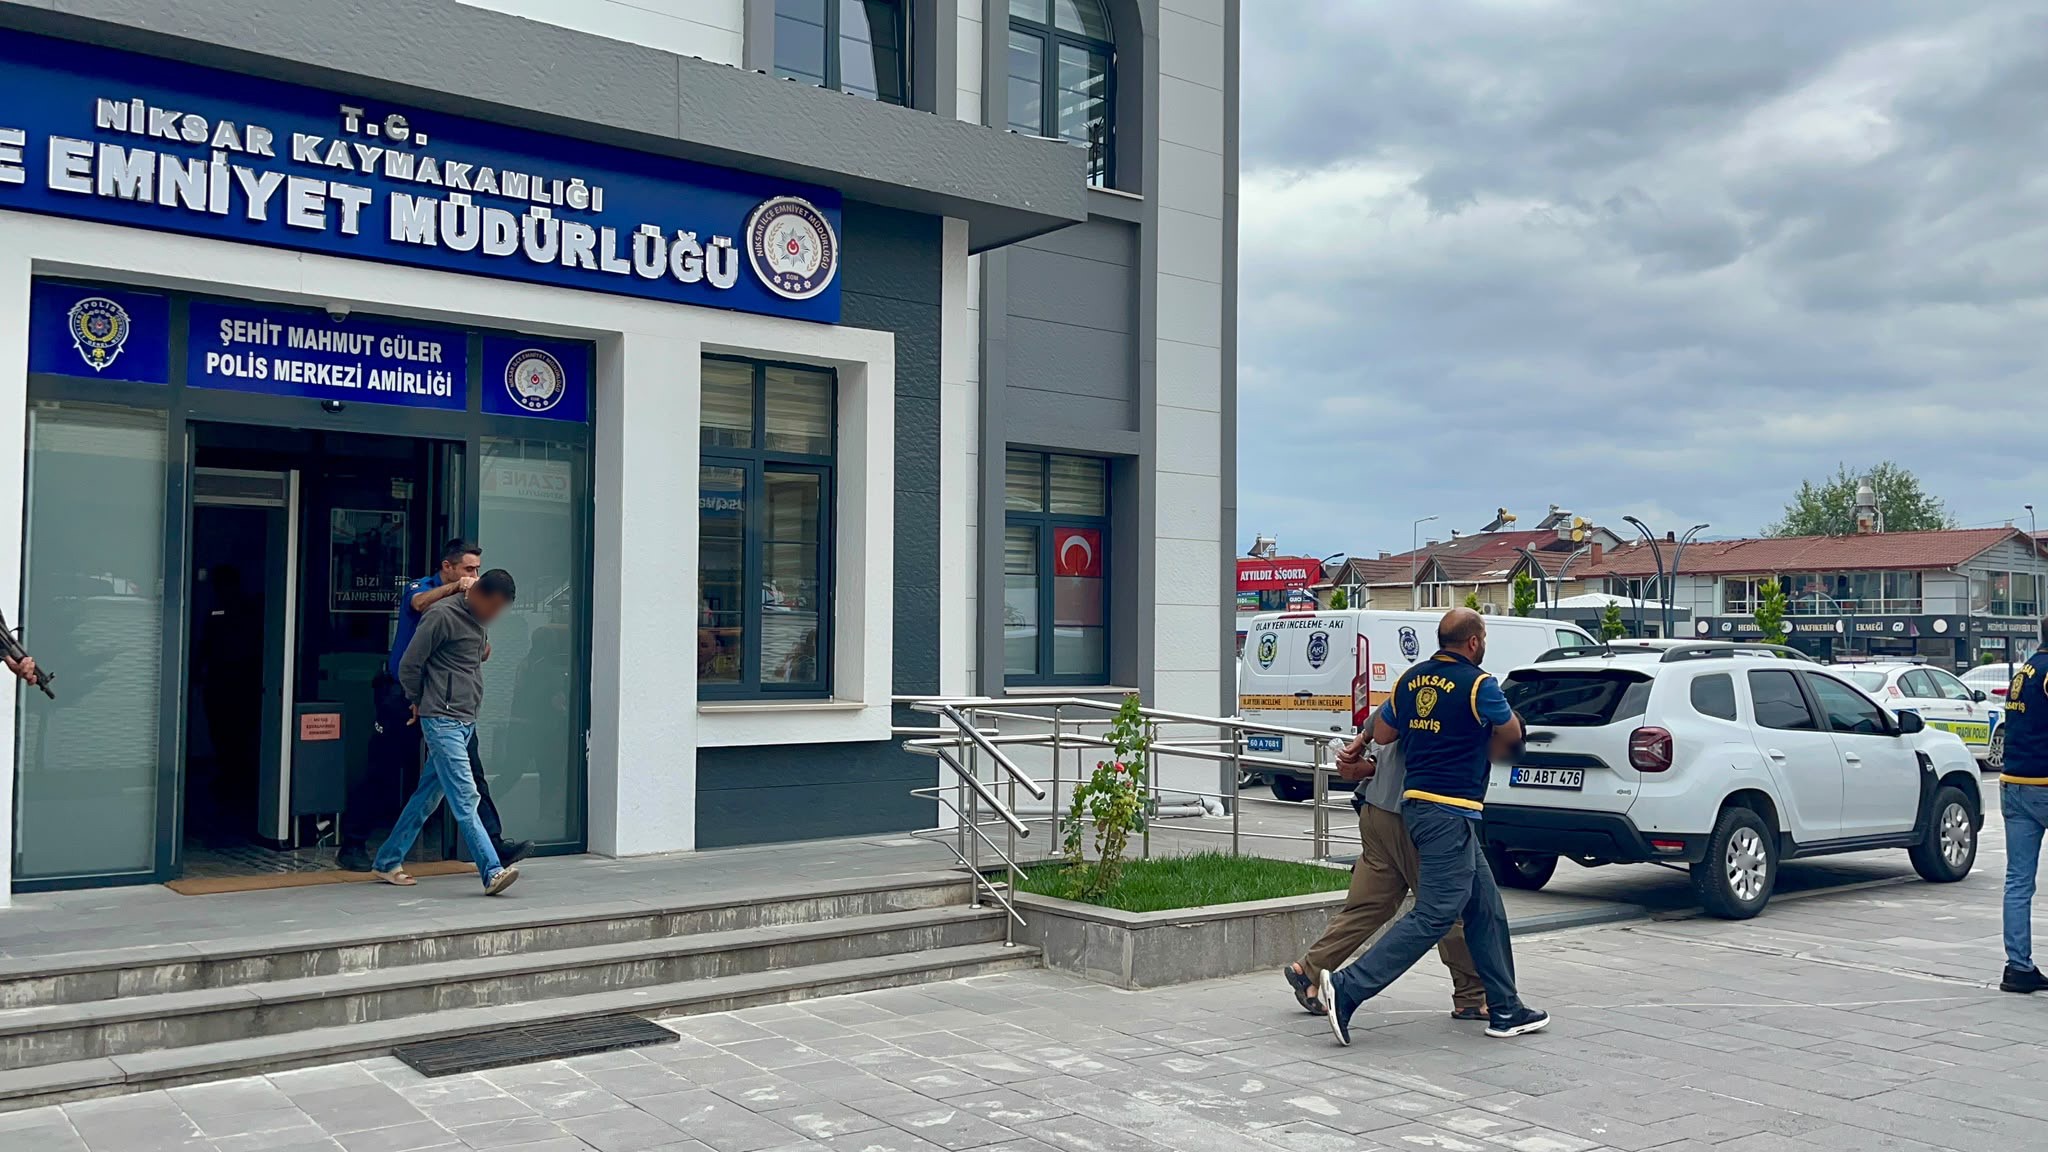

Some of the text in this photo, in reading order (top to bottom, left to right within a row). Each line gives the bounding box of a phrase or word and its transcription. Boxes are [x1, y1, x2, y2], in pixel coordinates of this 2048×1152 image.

[340, 104, 427, 146] T.C.
[96, 97, 603, 212] NİKSAR KAYMAKAMLIĞI
[48, 135, 373, 235] EMNİYET
[390, 191, 739, 289] MÜDÜRLÜĞÜ
[219, 318, 442, 363] ŞEHİT MAHMUT GÜLER
[207, 351, 452, 397] POLİS MERKEZİ AMİRLİĞİ
[1240, 567, 1307, 581] AYYILDIZ SİGORTA
[1256, 622, 1272, 631] OLAY
[1272, 621, 1287, 630] YERİ
[1287, 620, 1322, 629] İNCELEME
[1796, 622, 1834, 631] VAKFIKEBİR
[1856, 622, 1883, 631] EKMEĞİ
[1374, 665, 1385, 674] 112
[1407, 675, 1455, 693] NİKSAR
[1409, 718, 1441, 733] ASAYİŞ
[1250, 739, 1258, 747] 60
[1517, 769, 1580, 785] 60 ABT 476
